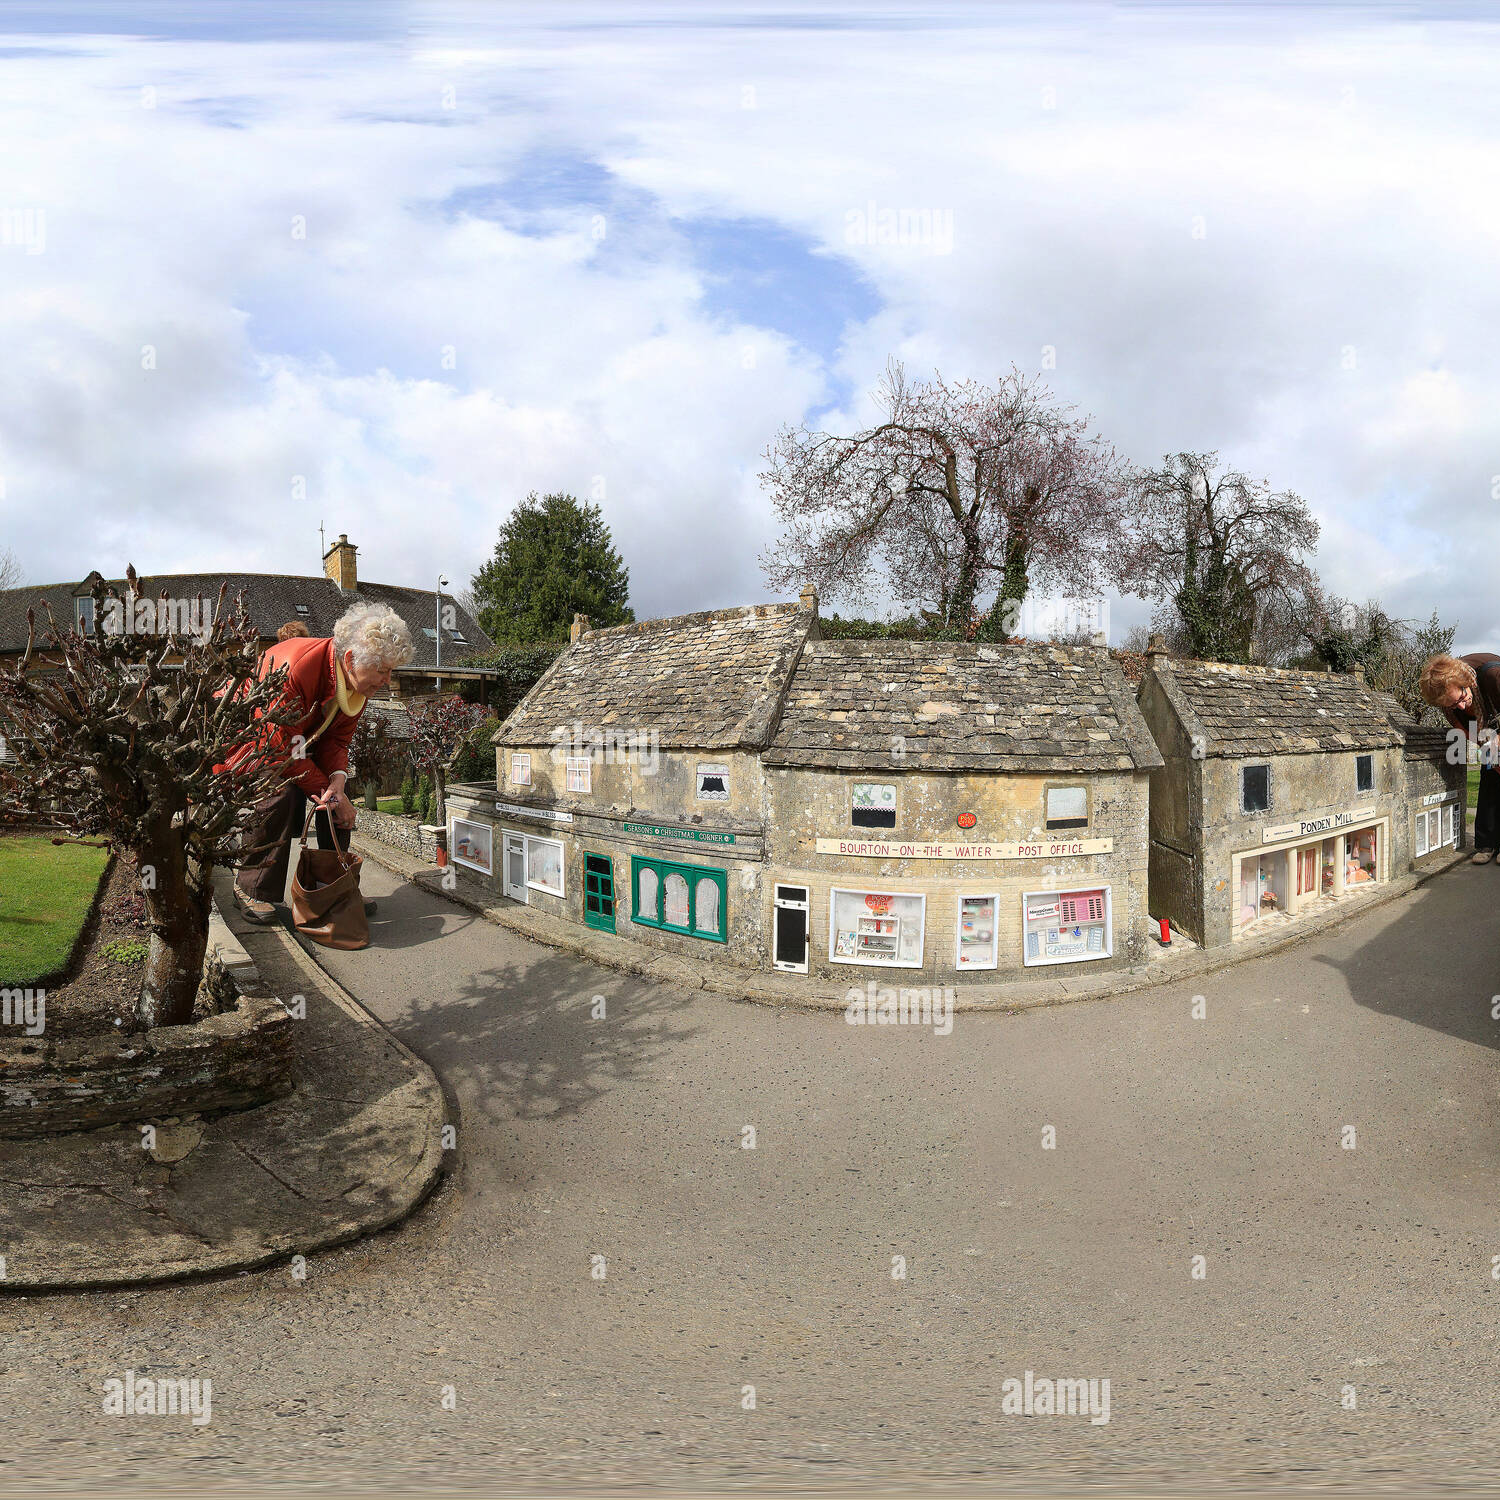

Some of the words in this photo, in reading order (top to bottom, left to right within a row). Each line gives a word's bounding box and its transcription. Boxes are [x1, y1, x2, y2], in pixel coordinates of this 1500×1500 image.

[627, 824, 654, 835] SEASONS
[660, 828, 695, 840] CHRISTMAS
[698, 832, 723, 842] CORNER
[1300, 817, 1331, 835] PONDEN
[1334, 813, 1353, 827] MILL
[1018, 845, 1043, 857] POST
[1050, 843, 1084, 855] OFFICE
